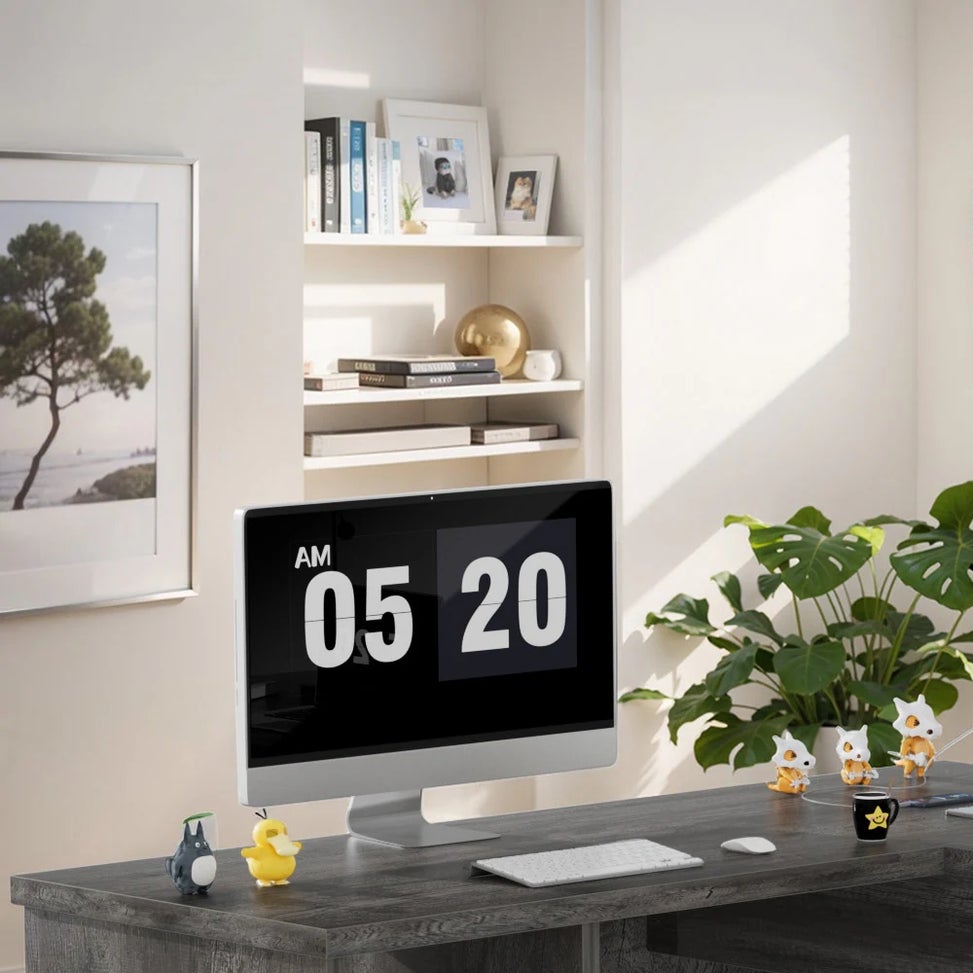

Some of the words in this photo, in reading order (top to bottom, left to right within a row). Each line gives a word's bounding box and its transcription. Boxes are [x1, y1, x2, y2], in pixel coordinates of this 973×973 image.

[295, 545, 330, 568] AM
[305, 566, 412, 667] 05
[462, 552, 566, 652] 20
